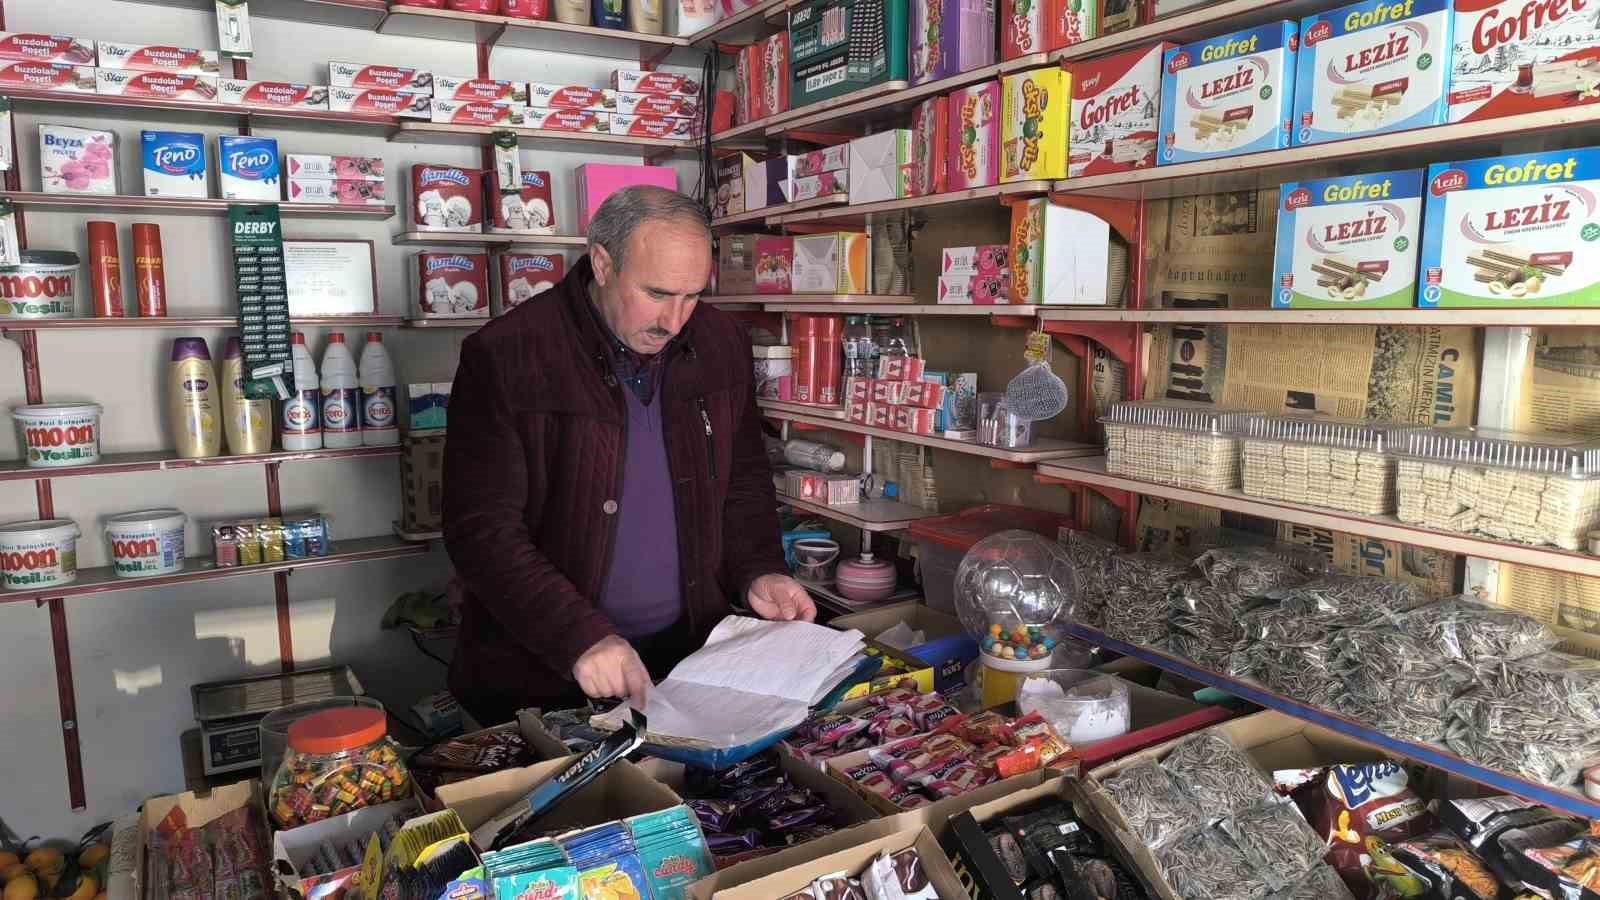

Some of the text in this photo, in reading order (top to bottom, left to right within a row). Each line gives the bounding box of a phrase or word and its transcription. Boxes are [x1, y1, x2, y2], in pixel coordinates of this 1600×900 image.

[1344, 0, 1414, 32] Gofret
[1201, 34, 1258, 62] Gofret
[1081, 85, 1141, 130] Gofret
[154, 146, 195, 166] Teno
[230, 151, 269, 170] Teno
[421, 168, 470, 185] familia
[1484, 157, 1577, 185] Gofret
[1324, 180, 1392, 202] Gofret
[1484, 194, 1570, 230] LEZİZ
[234, 222, 276, 234] DERBY
[427, 255, 474, 273] familia
[12, 301, 60, 314] Yeşil
[1434, 348, 1460, 424] CAMİL
[27, 425, 95, 447] moon
[112, 539, 158, 558] oon
